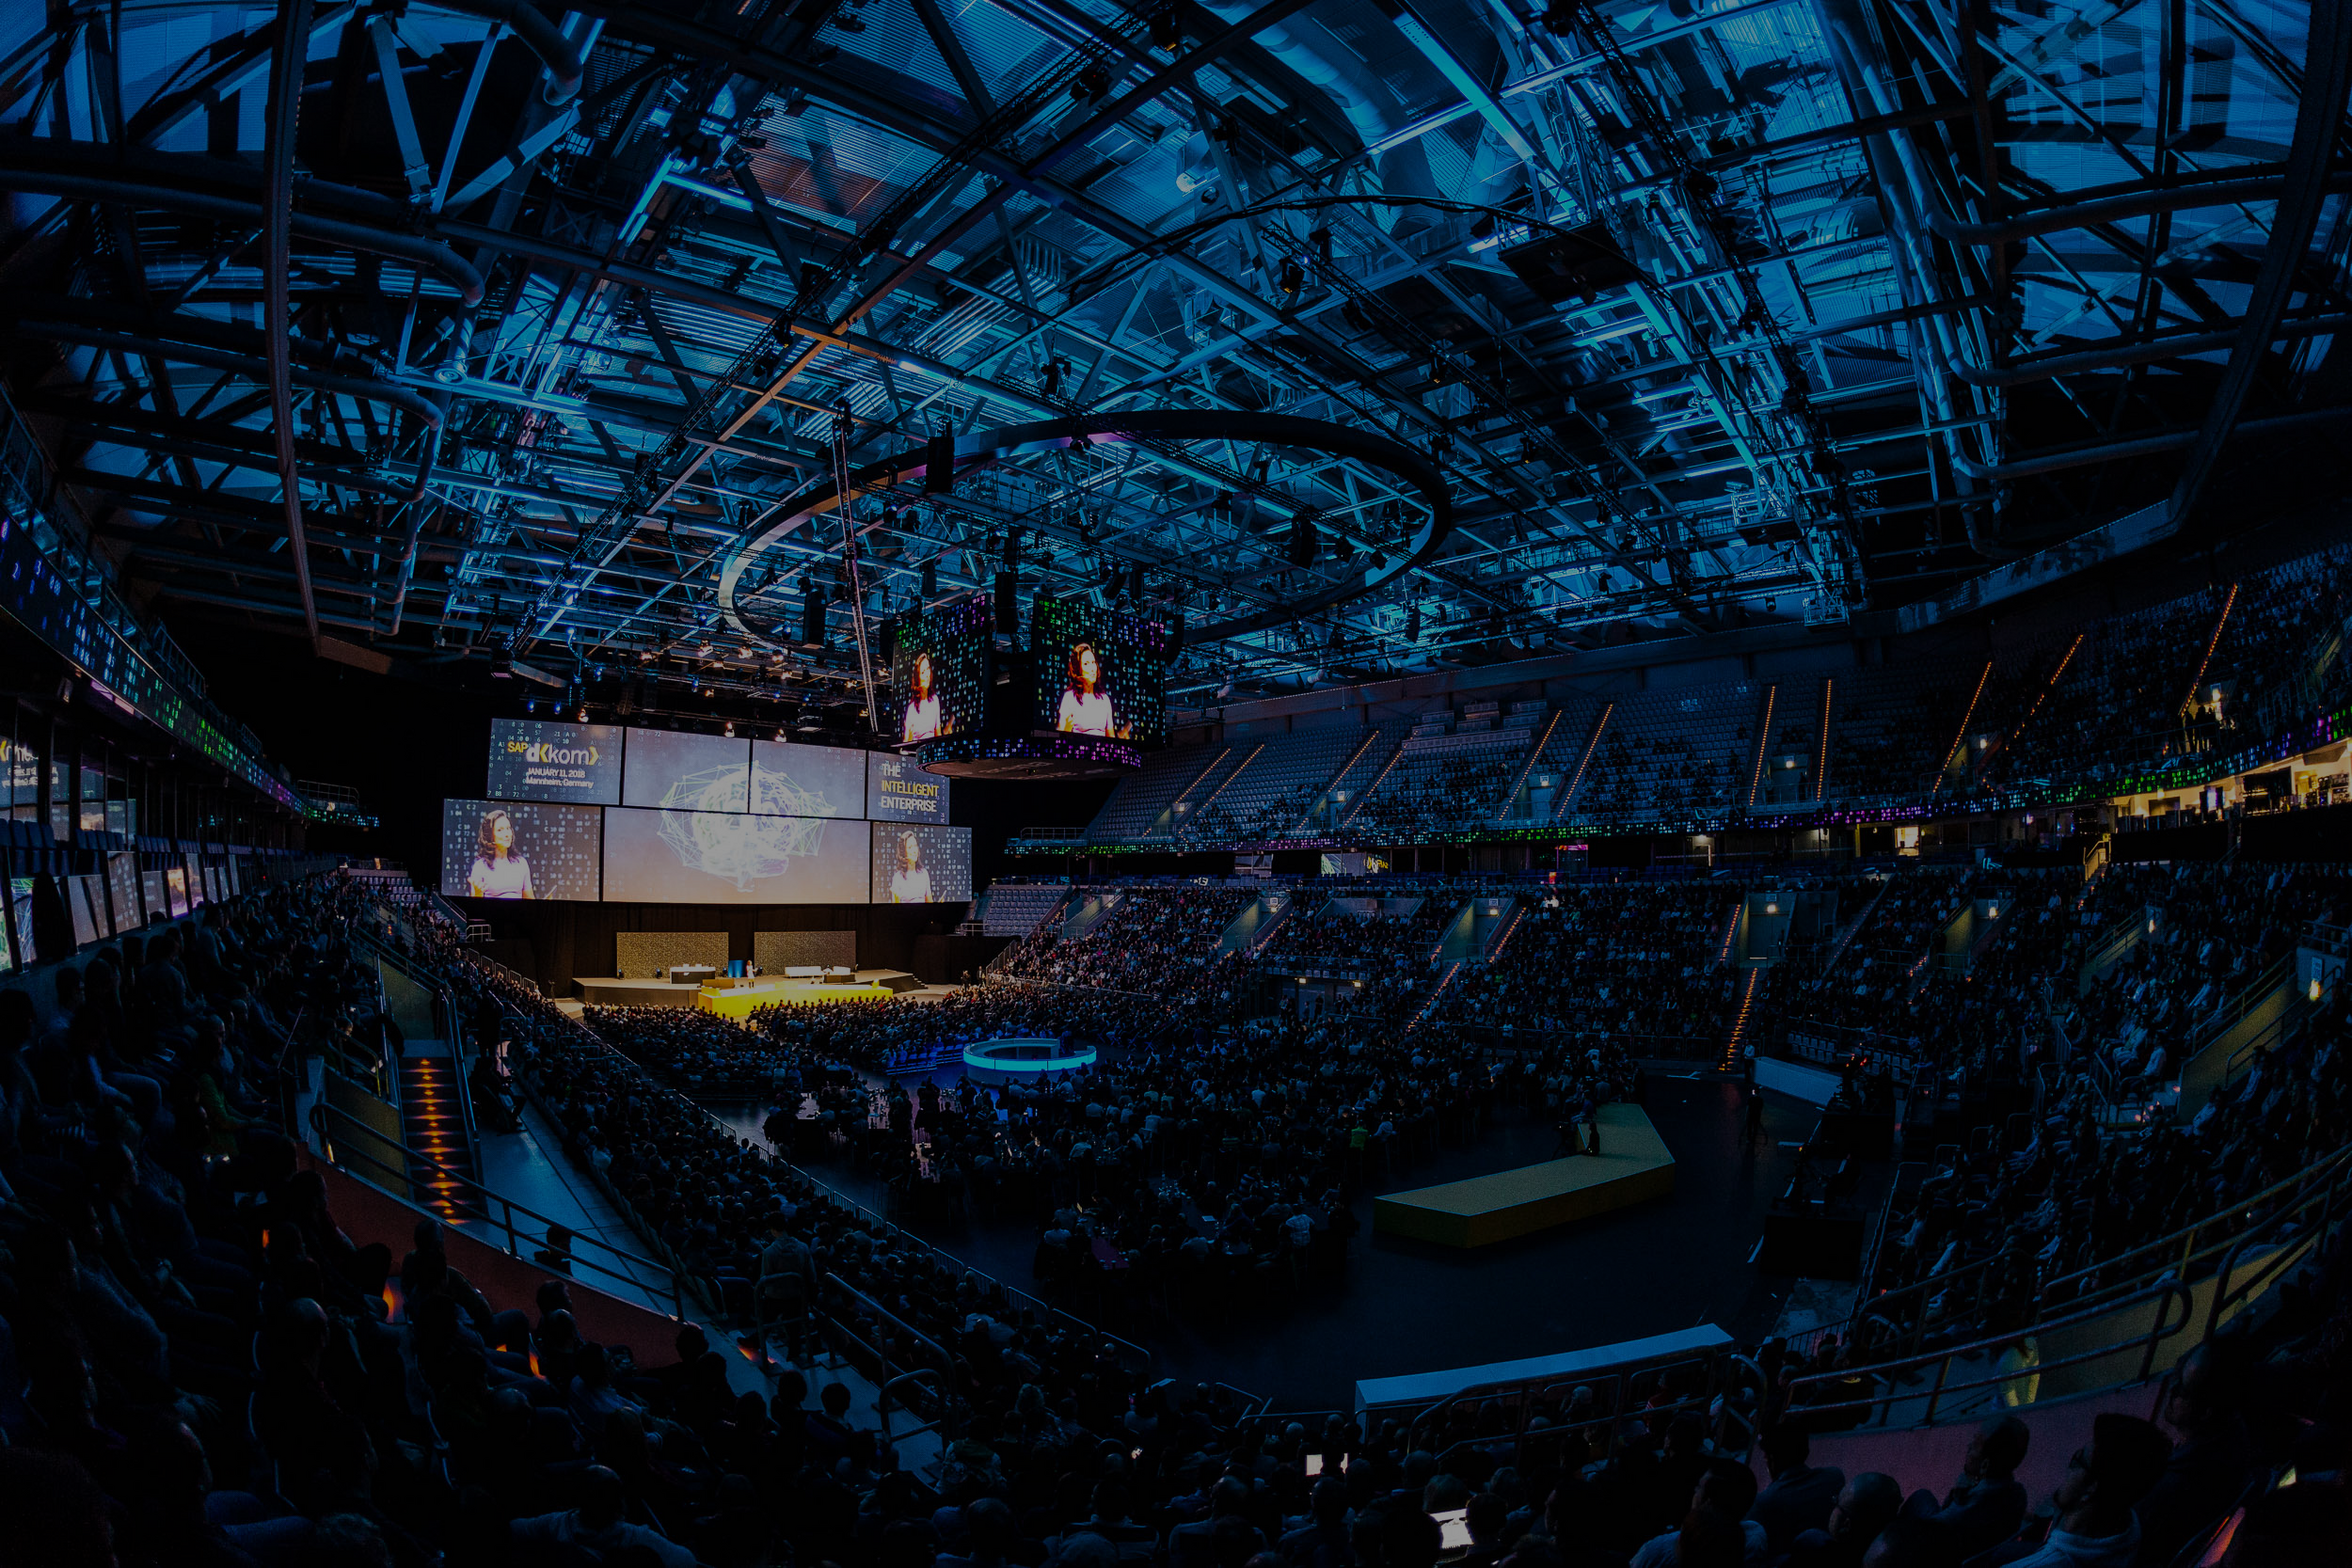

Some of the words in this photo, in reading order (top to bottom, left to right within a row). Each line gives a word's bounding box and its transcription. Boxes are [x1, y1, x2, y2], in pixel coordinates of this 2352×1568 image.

[508, 741, 528, 753] SAP
[527, 767, 558, 777] JANUARY
[568, 769, 585, 779] 2018
[882, 763, 902, 777] THE
[563, 778, 594, 789] Germany
[882, 780, 939, 797] INTELLIGENT
[881, 796, 937, 812] ENTERPRISE
